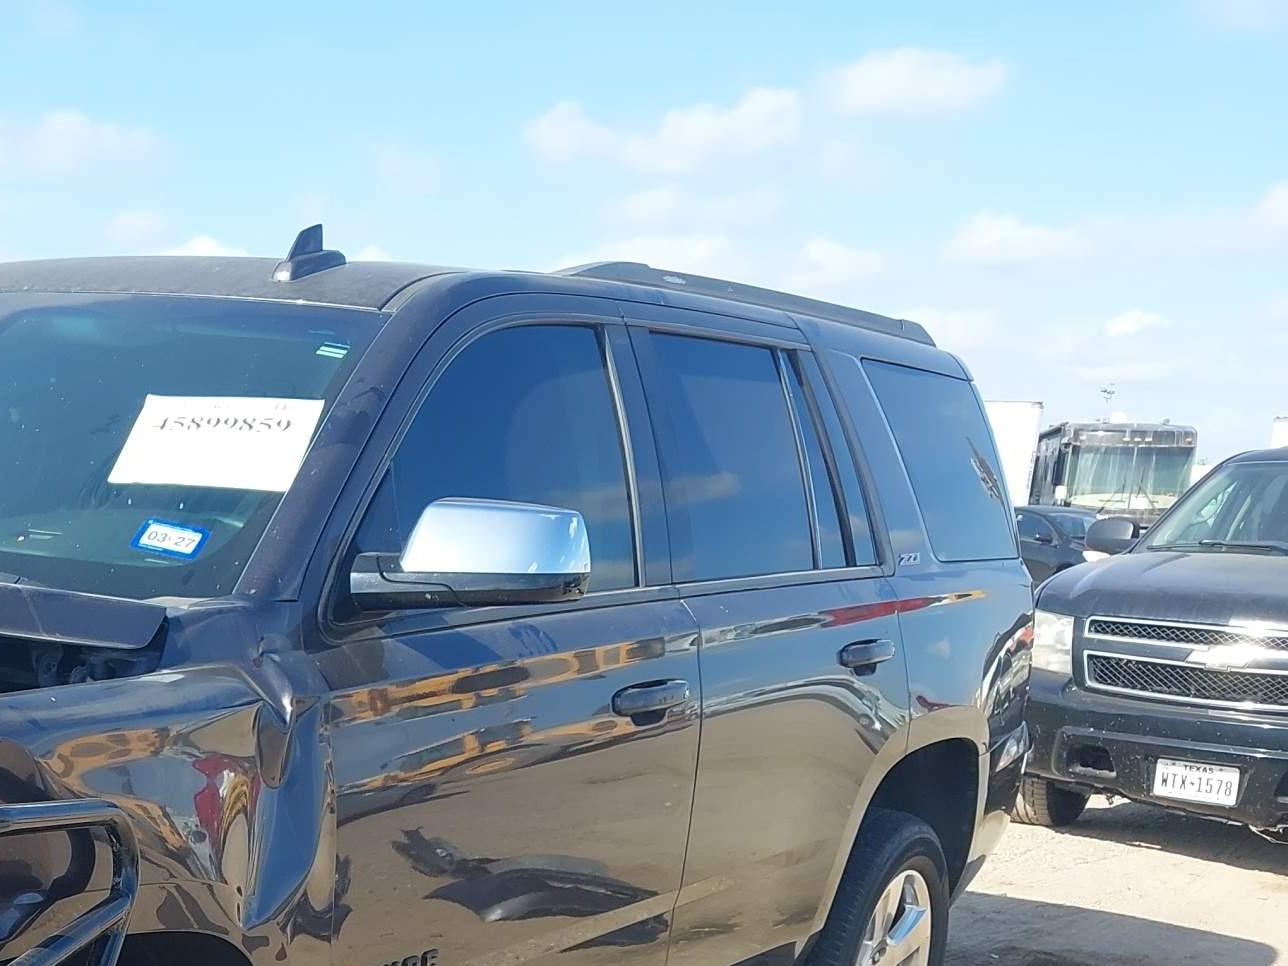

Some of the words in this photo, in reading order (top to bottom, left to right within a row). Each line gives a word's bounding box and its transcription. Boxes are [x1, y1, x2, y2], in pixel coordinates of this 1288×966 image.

[153, 416, 292, 432] 45899859
[147, 530, 168, 543] 03
[173, 536, 197, 549] 27
[1183, 764, 1214, 775] TEXAS
